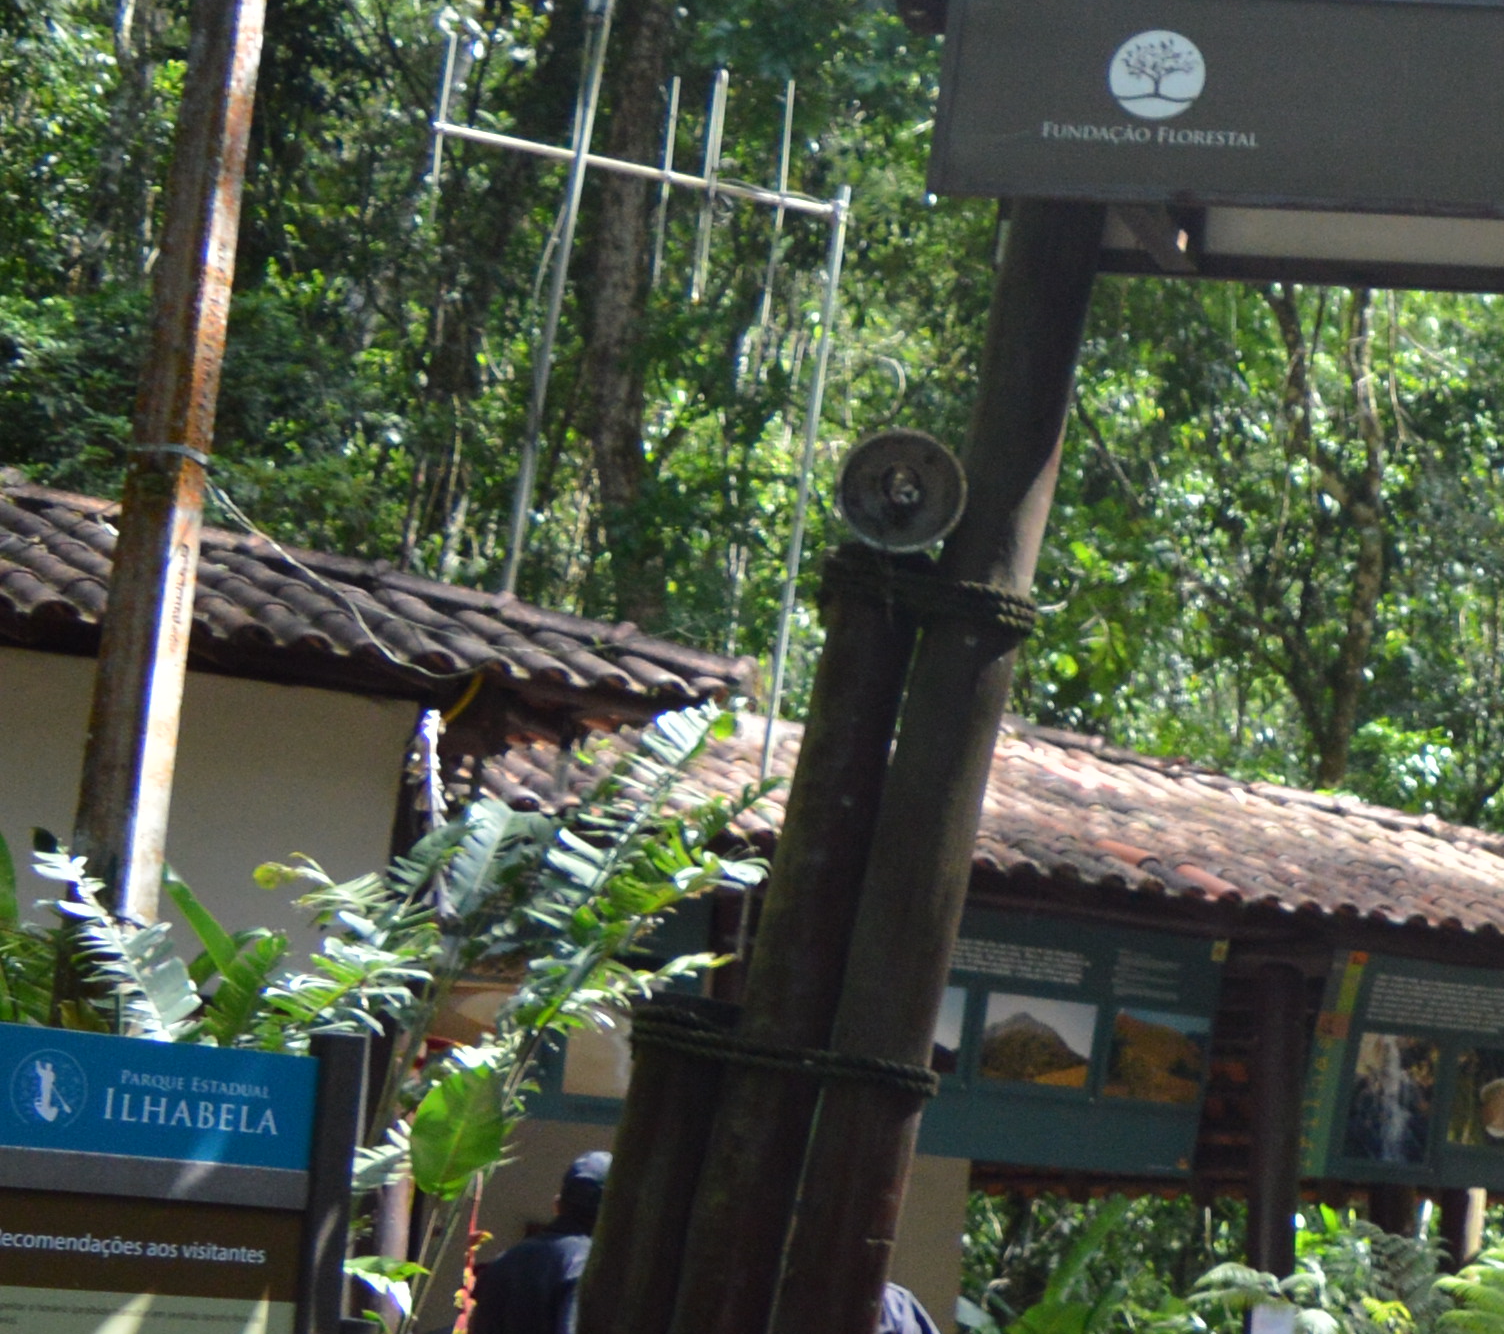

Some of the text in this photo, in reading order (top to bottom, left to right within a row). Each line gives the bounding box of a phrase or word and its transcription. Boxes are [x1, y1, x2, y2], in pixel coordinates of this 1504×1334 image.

[0, 1228, 266, 1264] ecomendações aos visitantes
